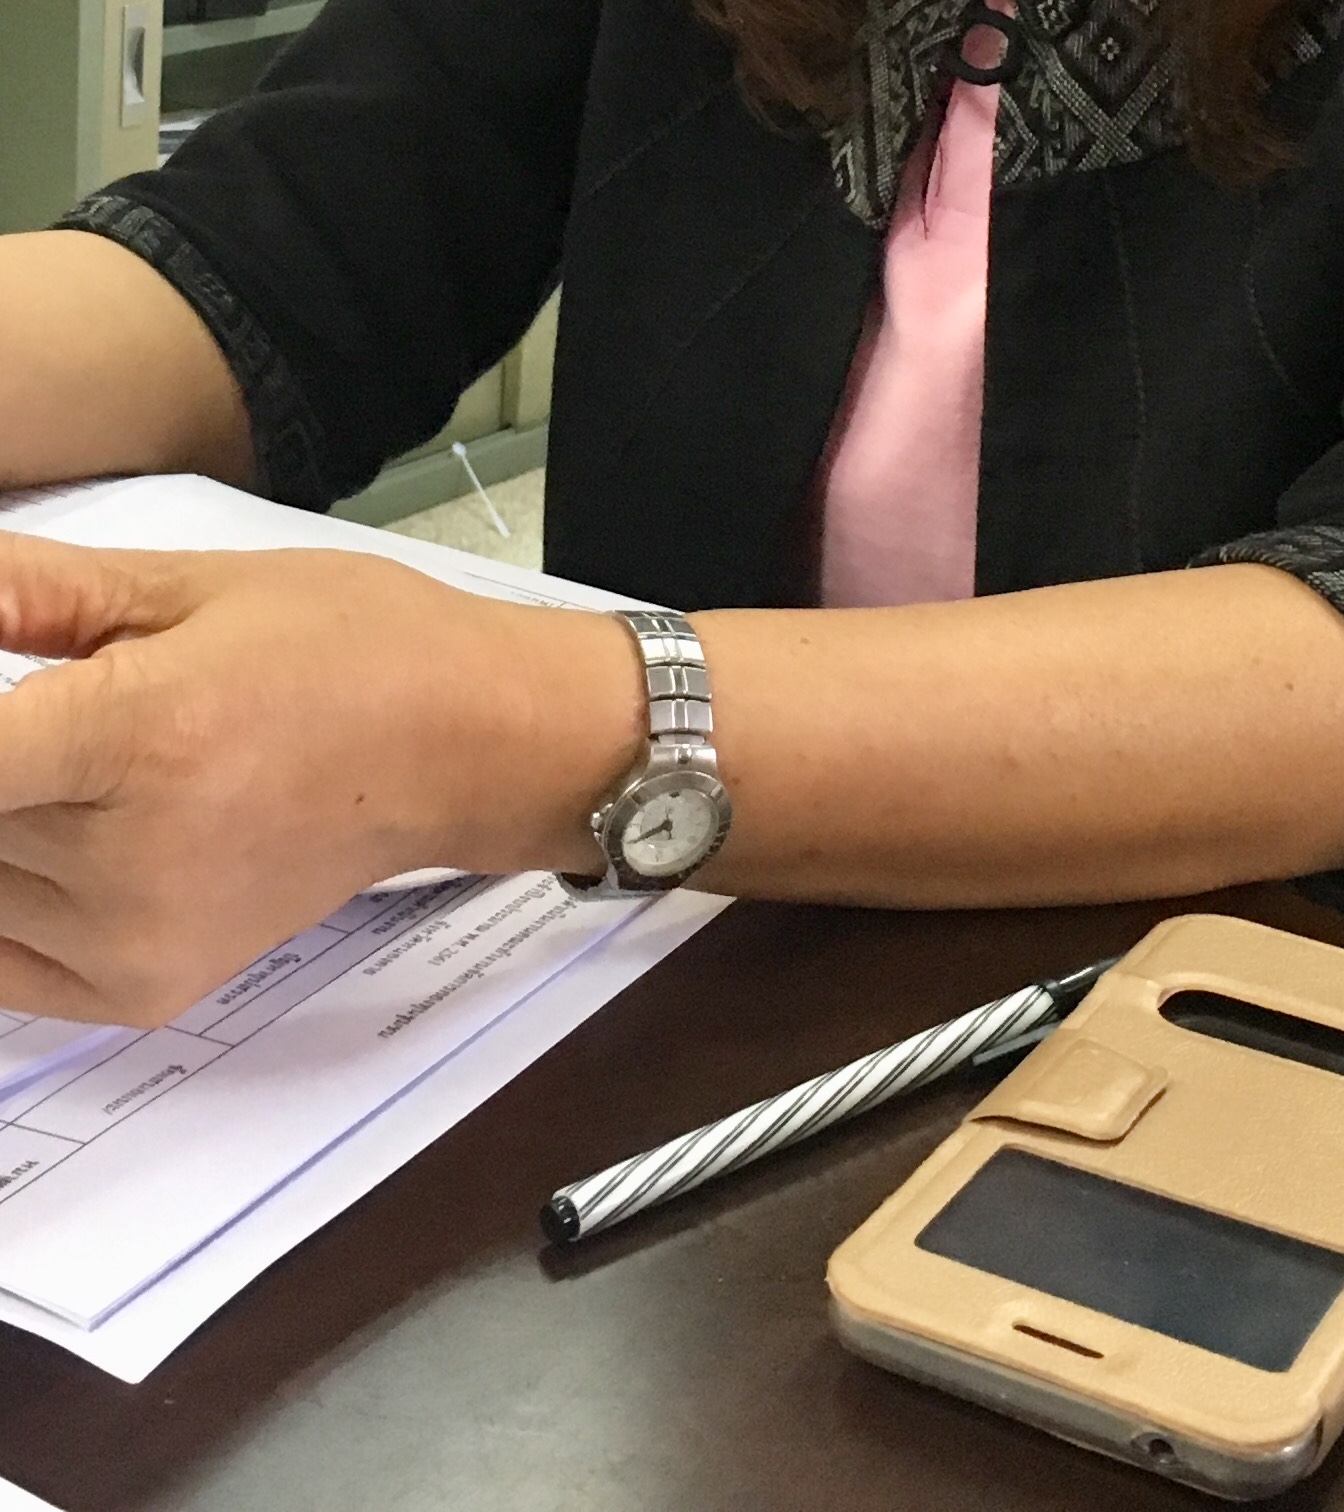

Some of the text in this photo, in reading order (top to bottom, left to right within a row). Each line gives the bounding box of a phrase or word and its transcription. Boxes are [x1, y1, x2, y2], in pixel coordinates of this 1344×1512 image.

[473, 875, 569, 933] ระจำปีงบประมาณ
[427, 947, 460, 966] 2561
